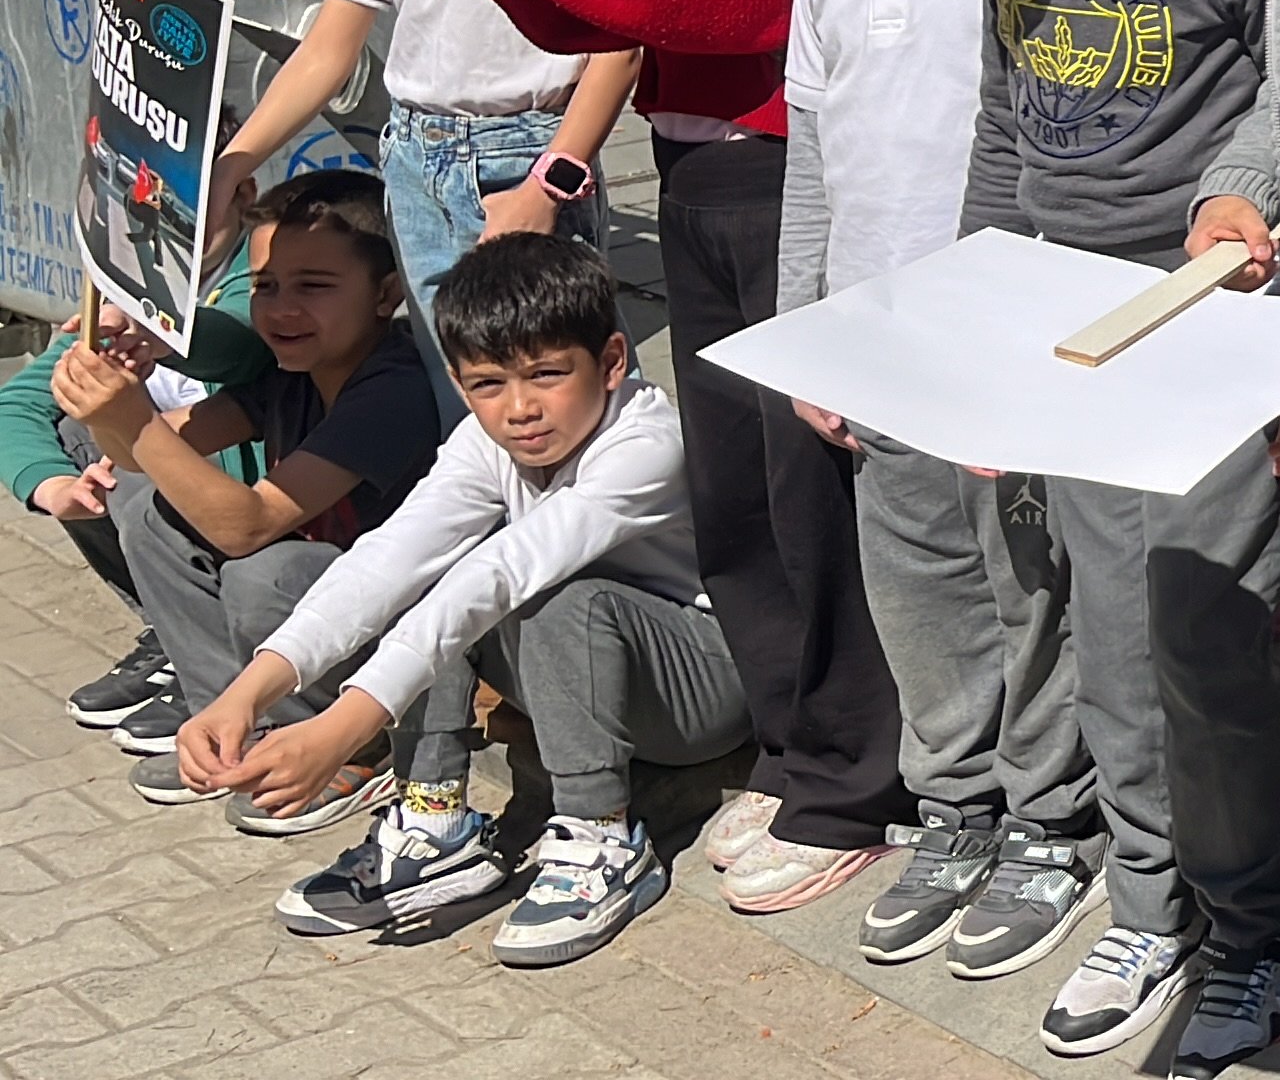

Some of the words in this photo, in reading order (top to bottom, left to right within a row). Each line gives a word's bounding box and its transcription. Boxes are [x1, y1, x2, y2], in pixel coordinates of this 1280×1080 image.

[95, 8, 135, 82] ATA
[1032, 119, 1083, 150] 1907
[1010, 510, 1043, 526] AIR
